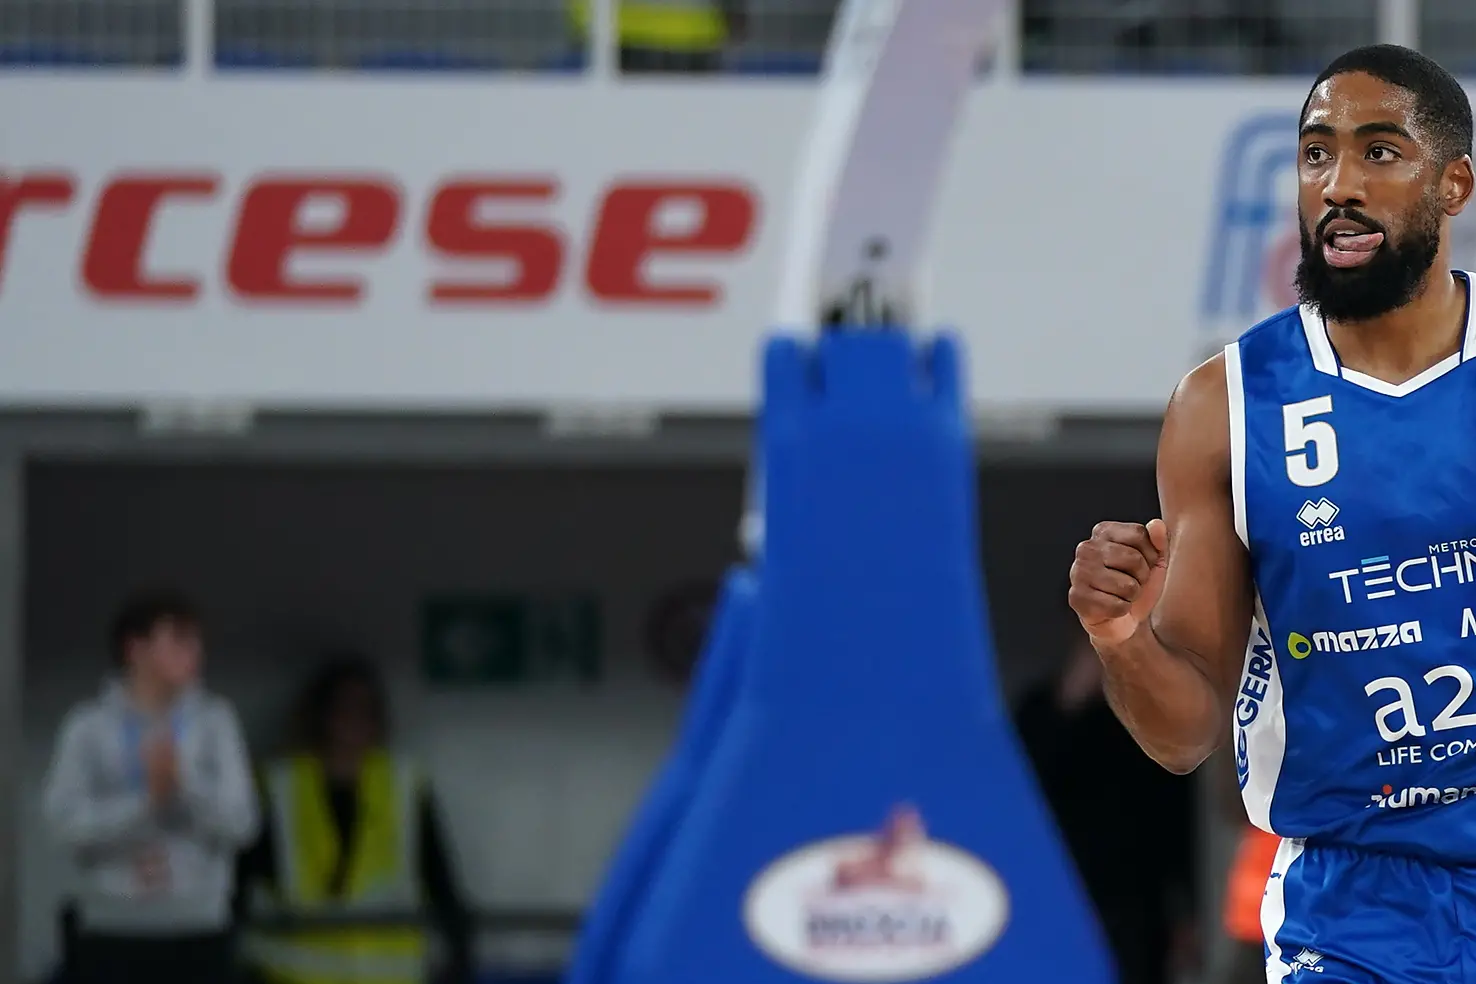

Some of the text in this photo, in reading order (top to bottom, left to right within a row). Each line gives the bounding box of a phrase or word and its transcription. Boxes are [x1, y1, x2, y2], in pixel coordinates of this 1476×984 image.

[1282, 394, 1340, 487] 5
[1311, 620, 1423, 653] mazza
[1377, 744, 1423, 766] LIFE
